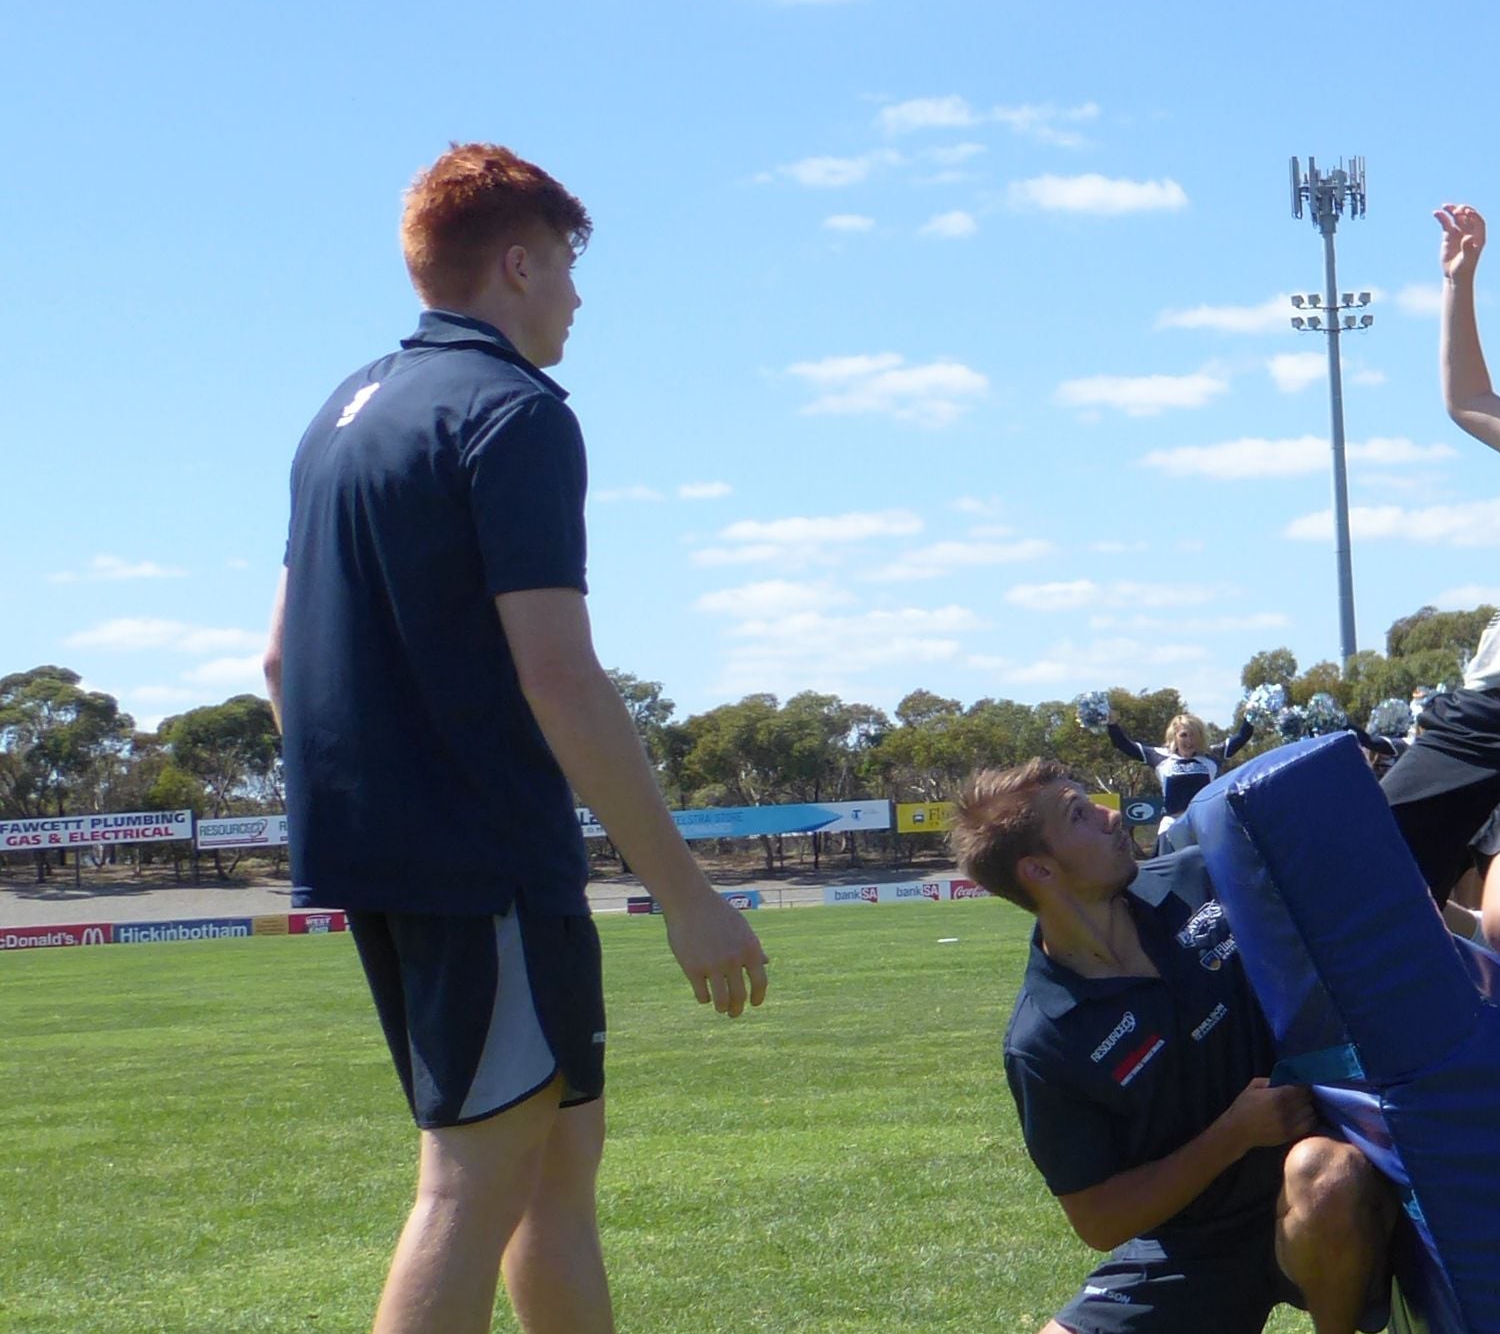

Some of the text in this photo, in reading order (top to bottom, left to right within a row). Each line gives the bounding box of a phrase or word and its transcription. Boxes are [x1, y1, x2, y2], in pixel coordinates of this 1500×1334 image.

[0, 813, 186, 835] FAWCETT PLUMBING
[6, 826, 174, 846] GAS & ELECTRICAL
[834, 887, 878, 901] bankSA
[896, 884, 940, 898] bankSA
[0, 932, 74, 947] cDonald's
[120, 924, 248, 942] Hickinbotham
